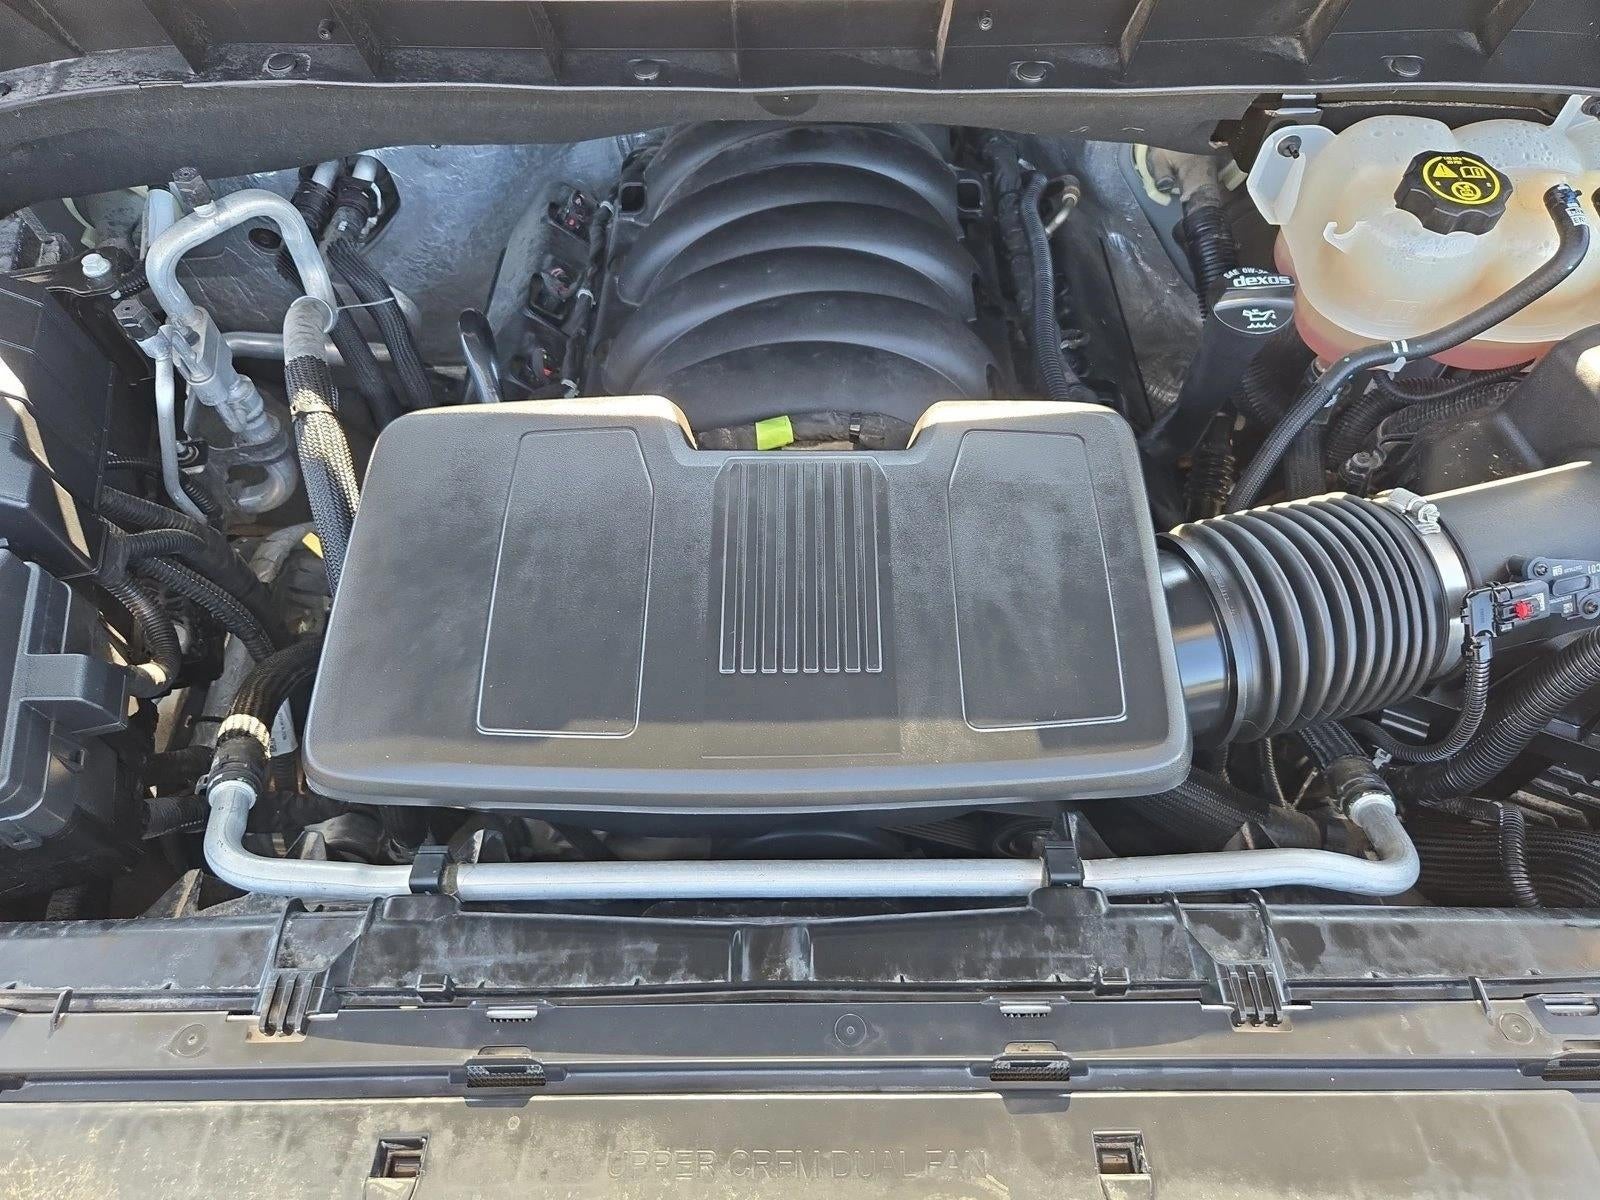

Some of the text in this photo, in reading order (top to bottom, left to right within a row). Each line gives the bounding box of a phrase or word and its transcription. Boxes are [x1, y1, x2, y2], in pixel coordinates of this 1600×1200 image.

[1223, 269, 1240, 279] SAE
[1233, 275, 1291, 287] dexos
[607, 1149, 718, 1180] UPPER
[831, 1149, 919, 1178] DUAL
[926, 1149, 988, 1178] FAN
